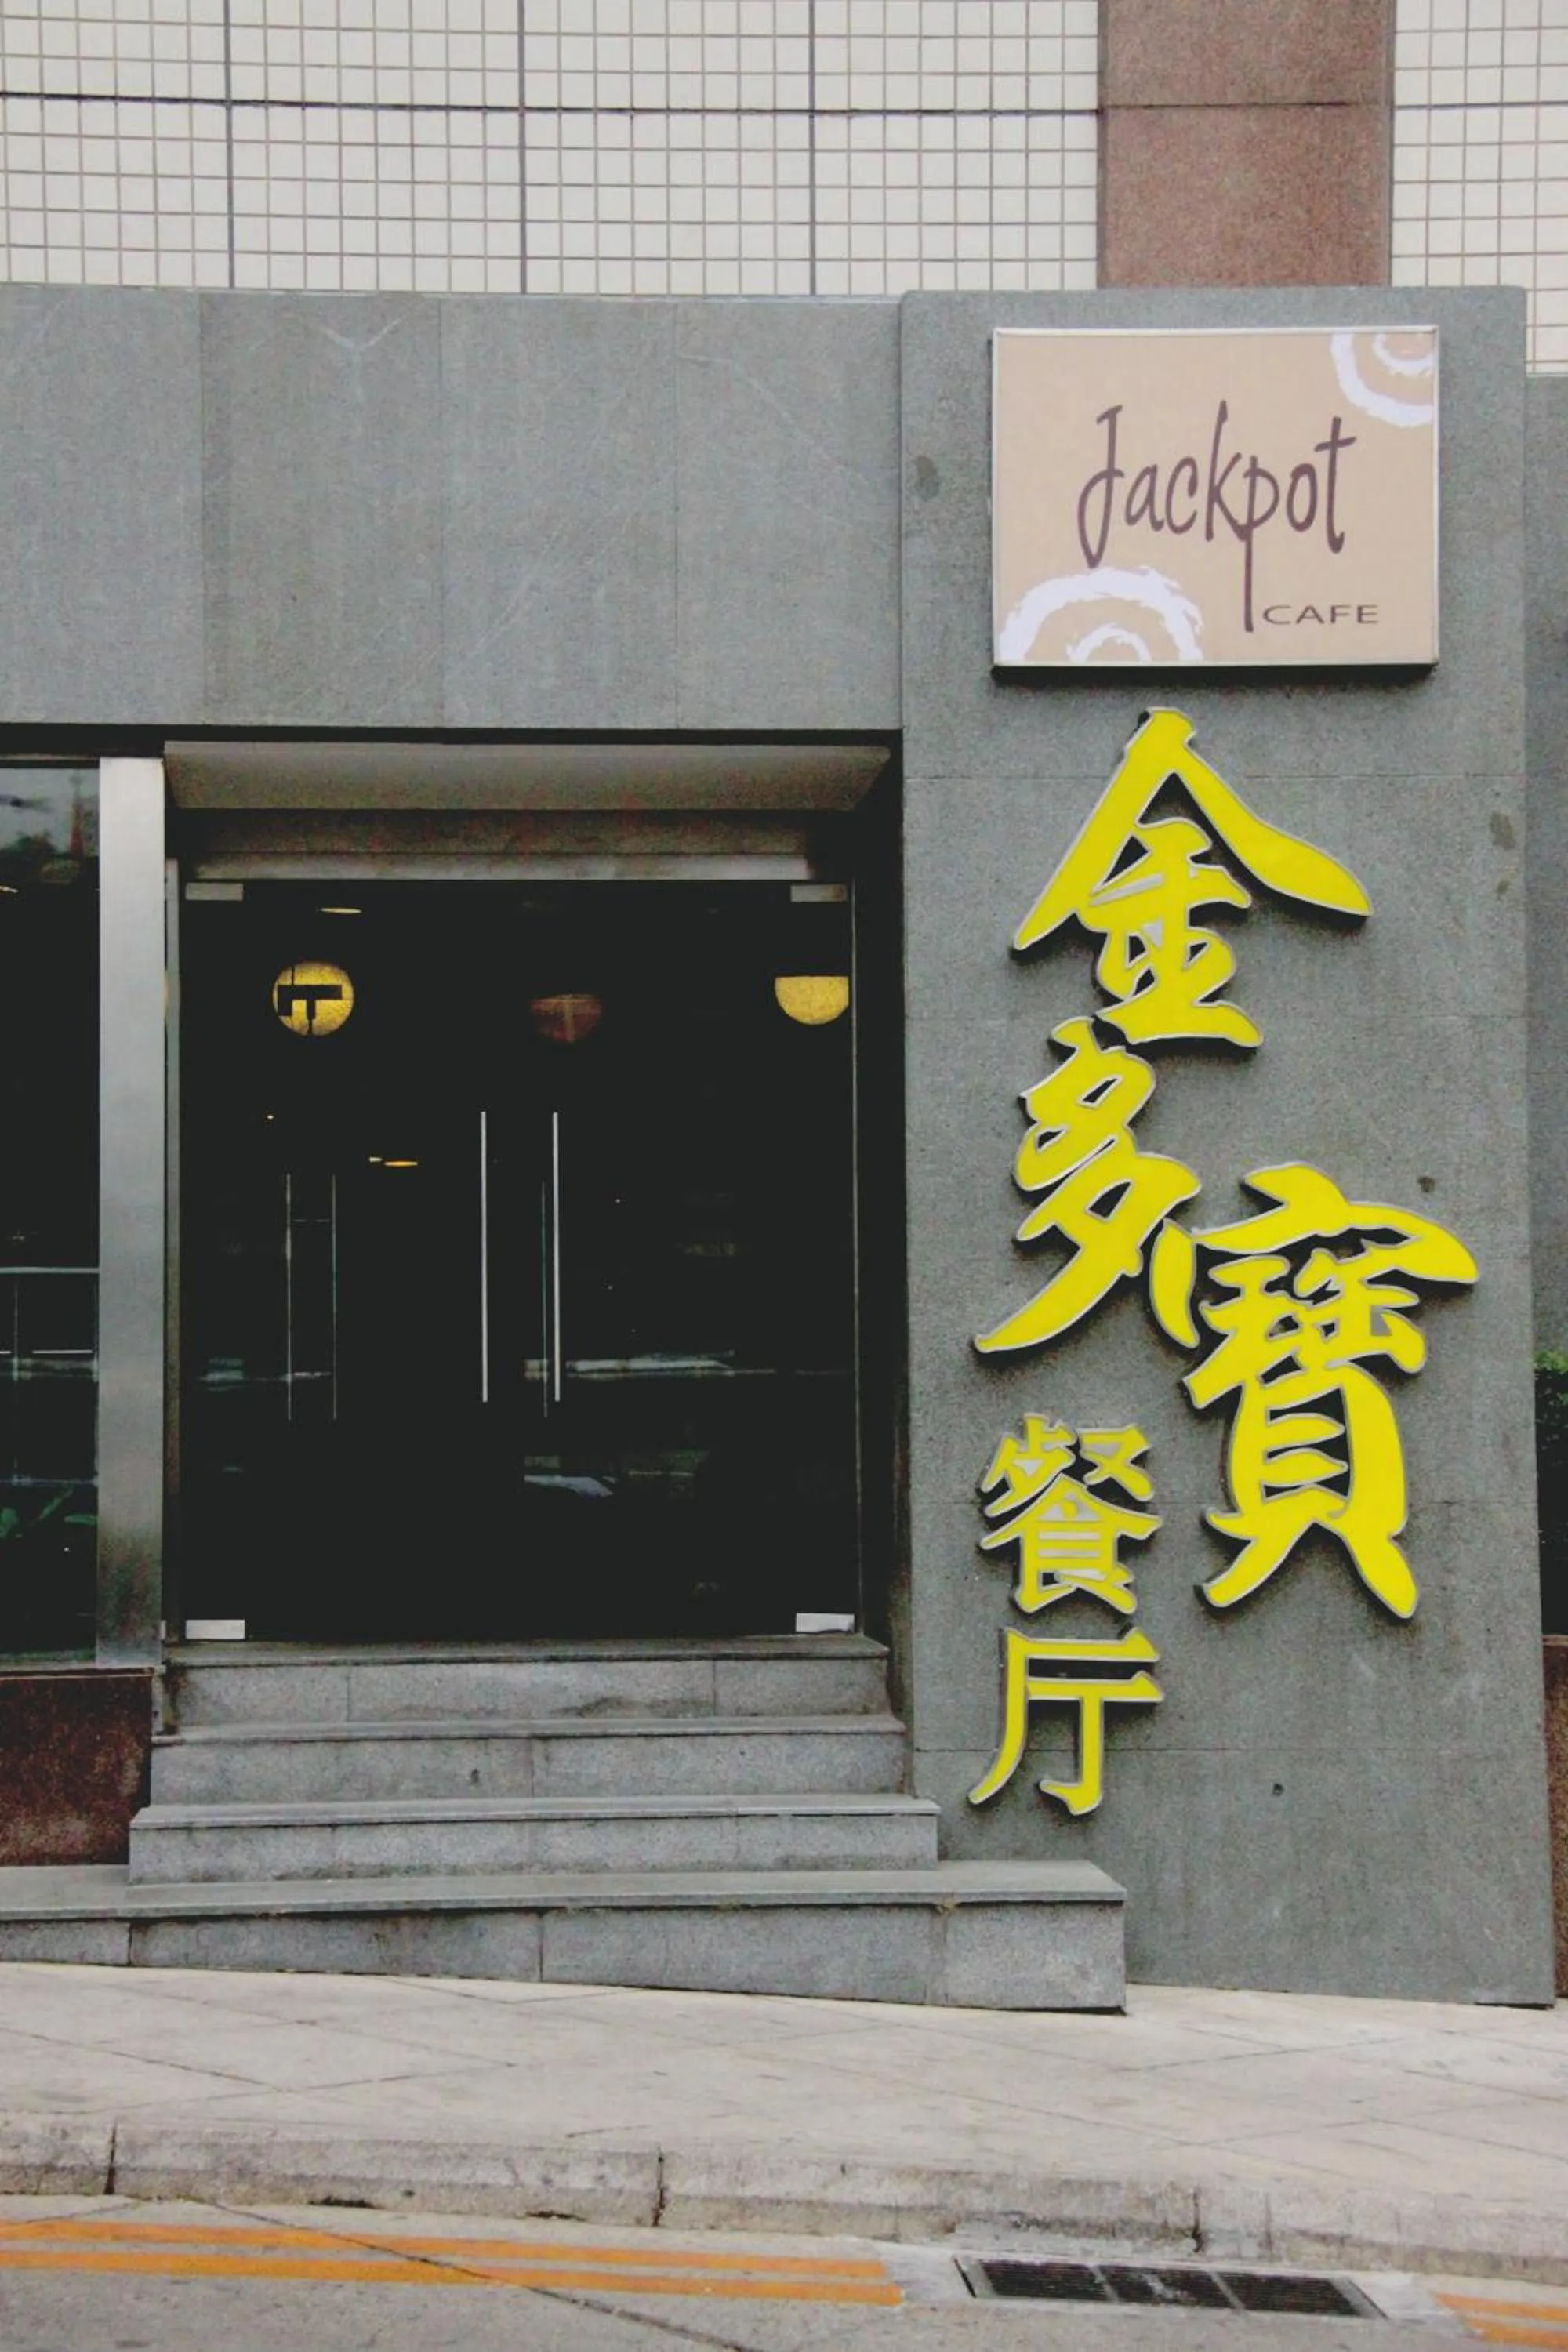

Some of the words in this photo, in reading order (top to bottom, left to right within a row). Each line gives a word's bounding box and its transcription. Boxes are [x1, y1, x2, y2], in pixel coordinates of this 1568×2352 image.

[1076, 400, 1357, 633] Jackpot
[1261, 604, 1381, 626] CAFE
[967, 1413, 1165, 1816] 餐厅
